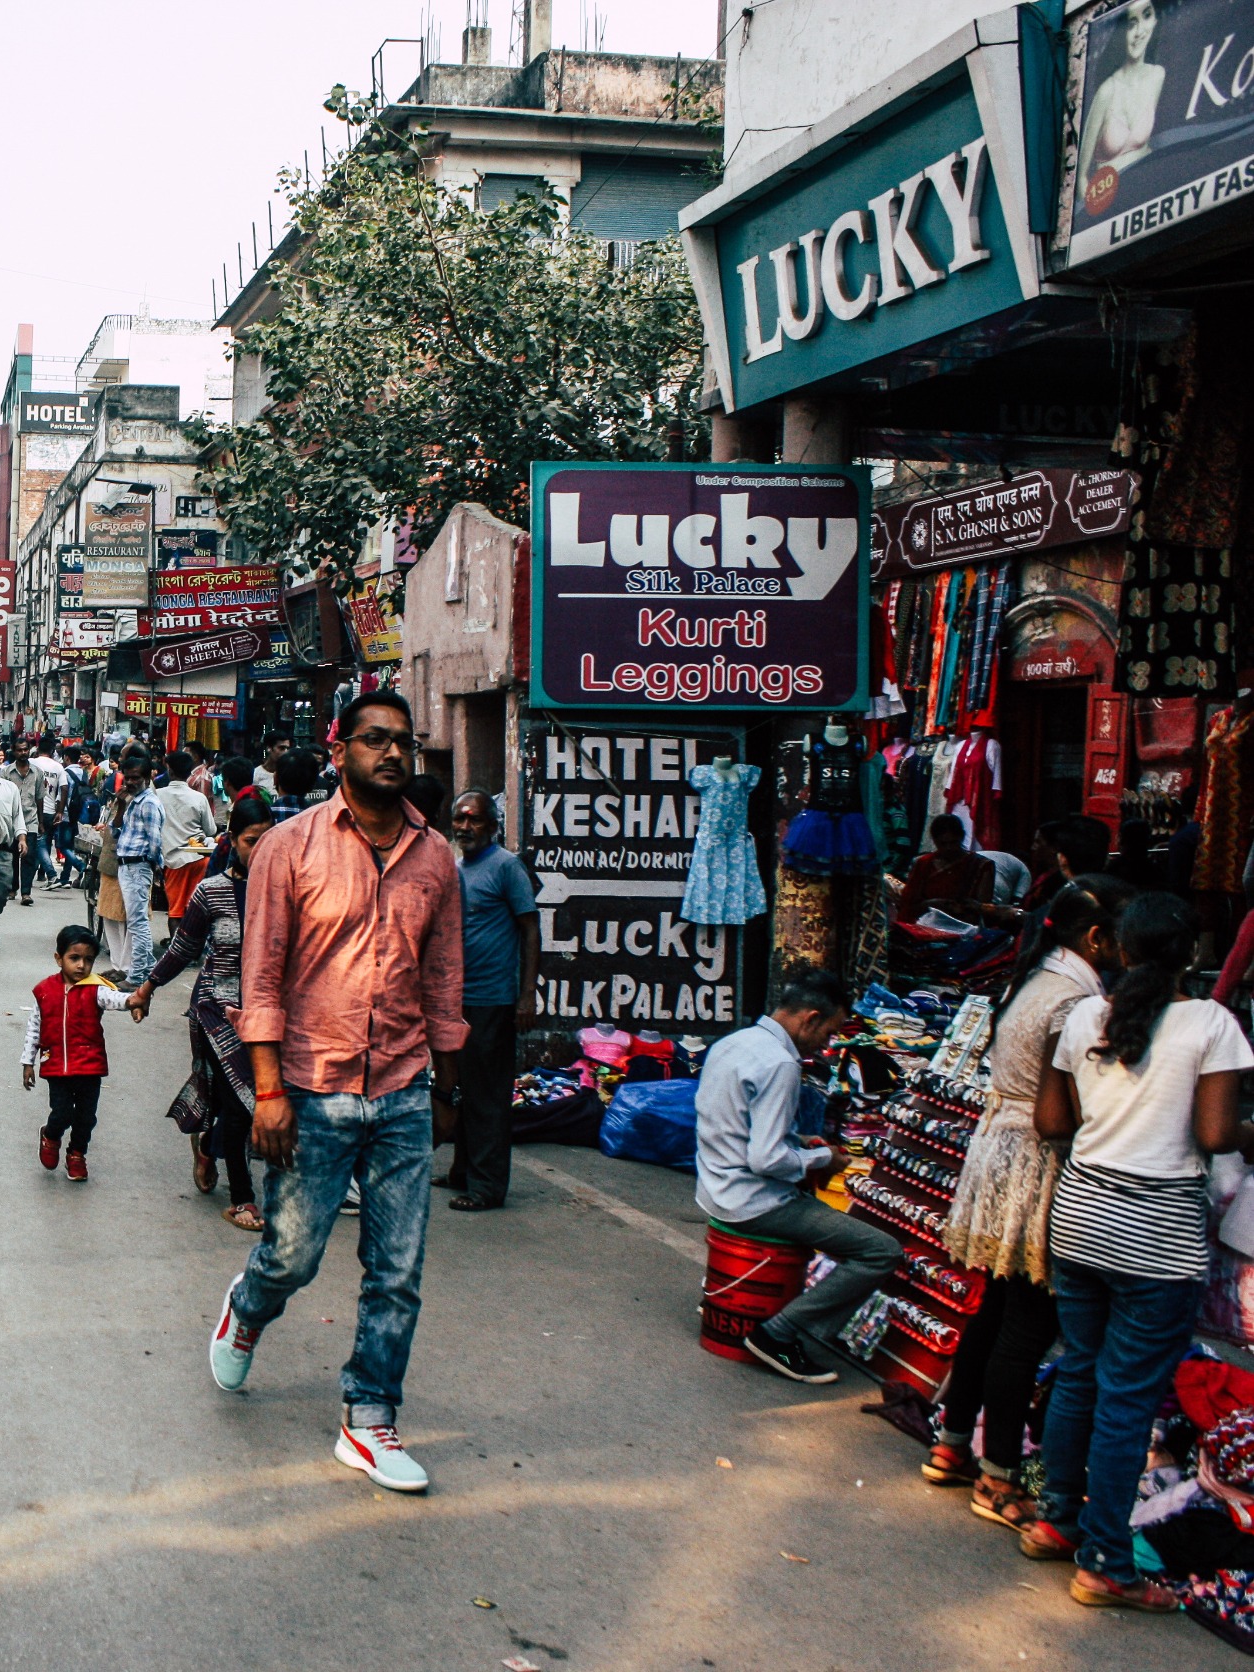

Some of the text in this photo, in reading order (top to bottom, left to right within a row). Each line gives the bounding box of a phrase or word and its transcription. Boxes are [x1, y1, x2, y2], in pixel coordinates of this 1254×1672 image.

[1109, 180, 1208, 246] LIBERTY
[737, 137, 991, 365] LUCKY
[26, 404, 86, 423] HOTEL
[695, 475, 731, 485] Under
[1086, 485, 1113, 499] DEALER
[1092, 497, 1123, 512] CEMENT
[958, 516, 997, 541] GHOSH
[1012, 506, 1042, 529] SONS
[86, 546, 146, 556] RESTAURANT
[550, 492, 858, 601] Lucky
[86, 560, 146, 573] MONGA
[625, 570, 781, 595] Silk Palace
[197, 588, 280, 607] RESTAURANT
[639, 608, 766, 648] Kurti
[184, 646, 232, 664] SHEETAL
[189, 639, 220, 653] शीतल
[580, 653, 823, 702] Leggings
[534, 846, 595, 871] AC/NON
[538, 907, 727, 982] Lucky
[609, 973, 734, 1023] PALACE
